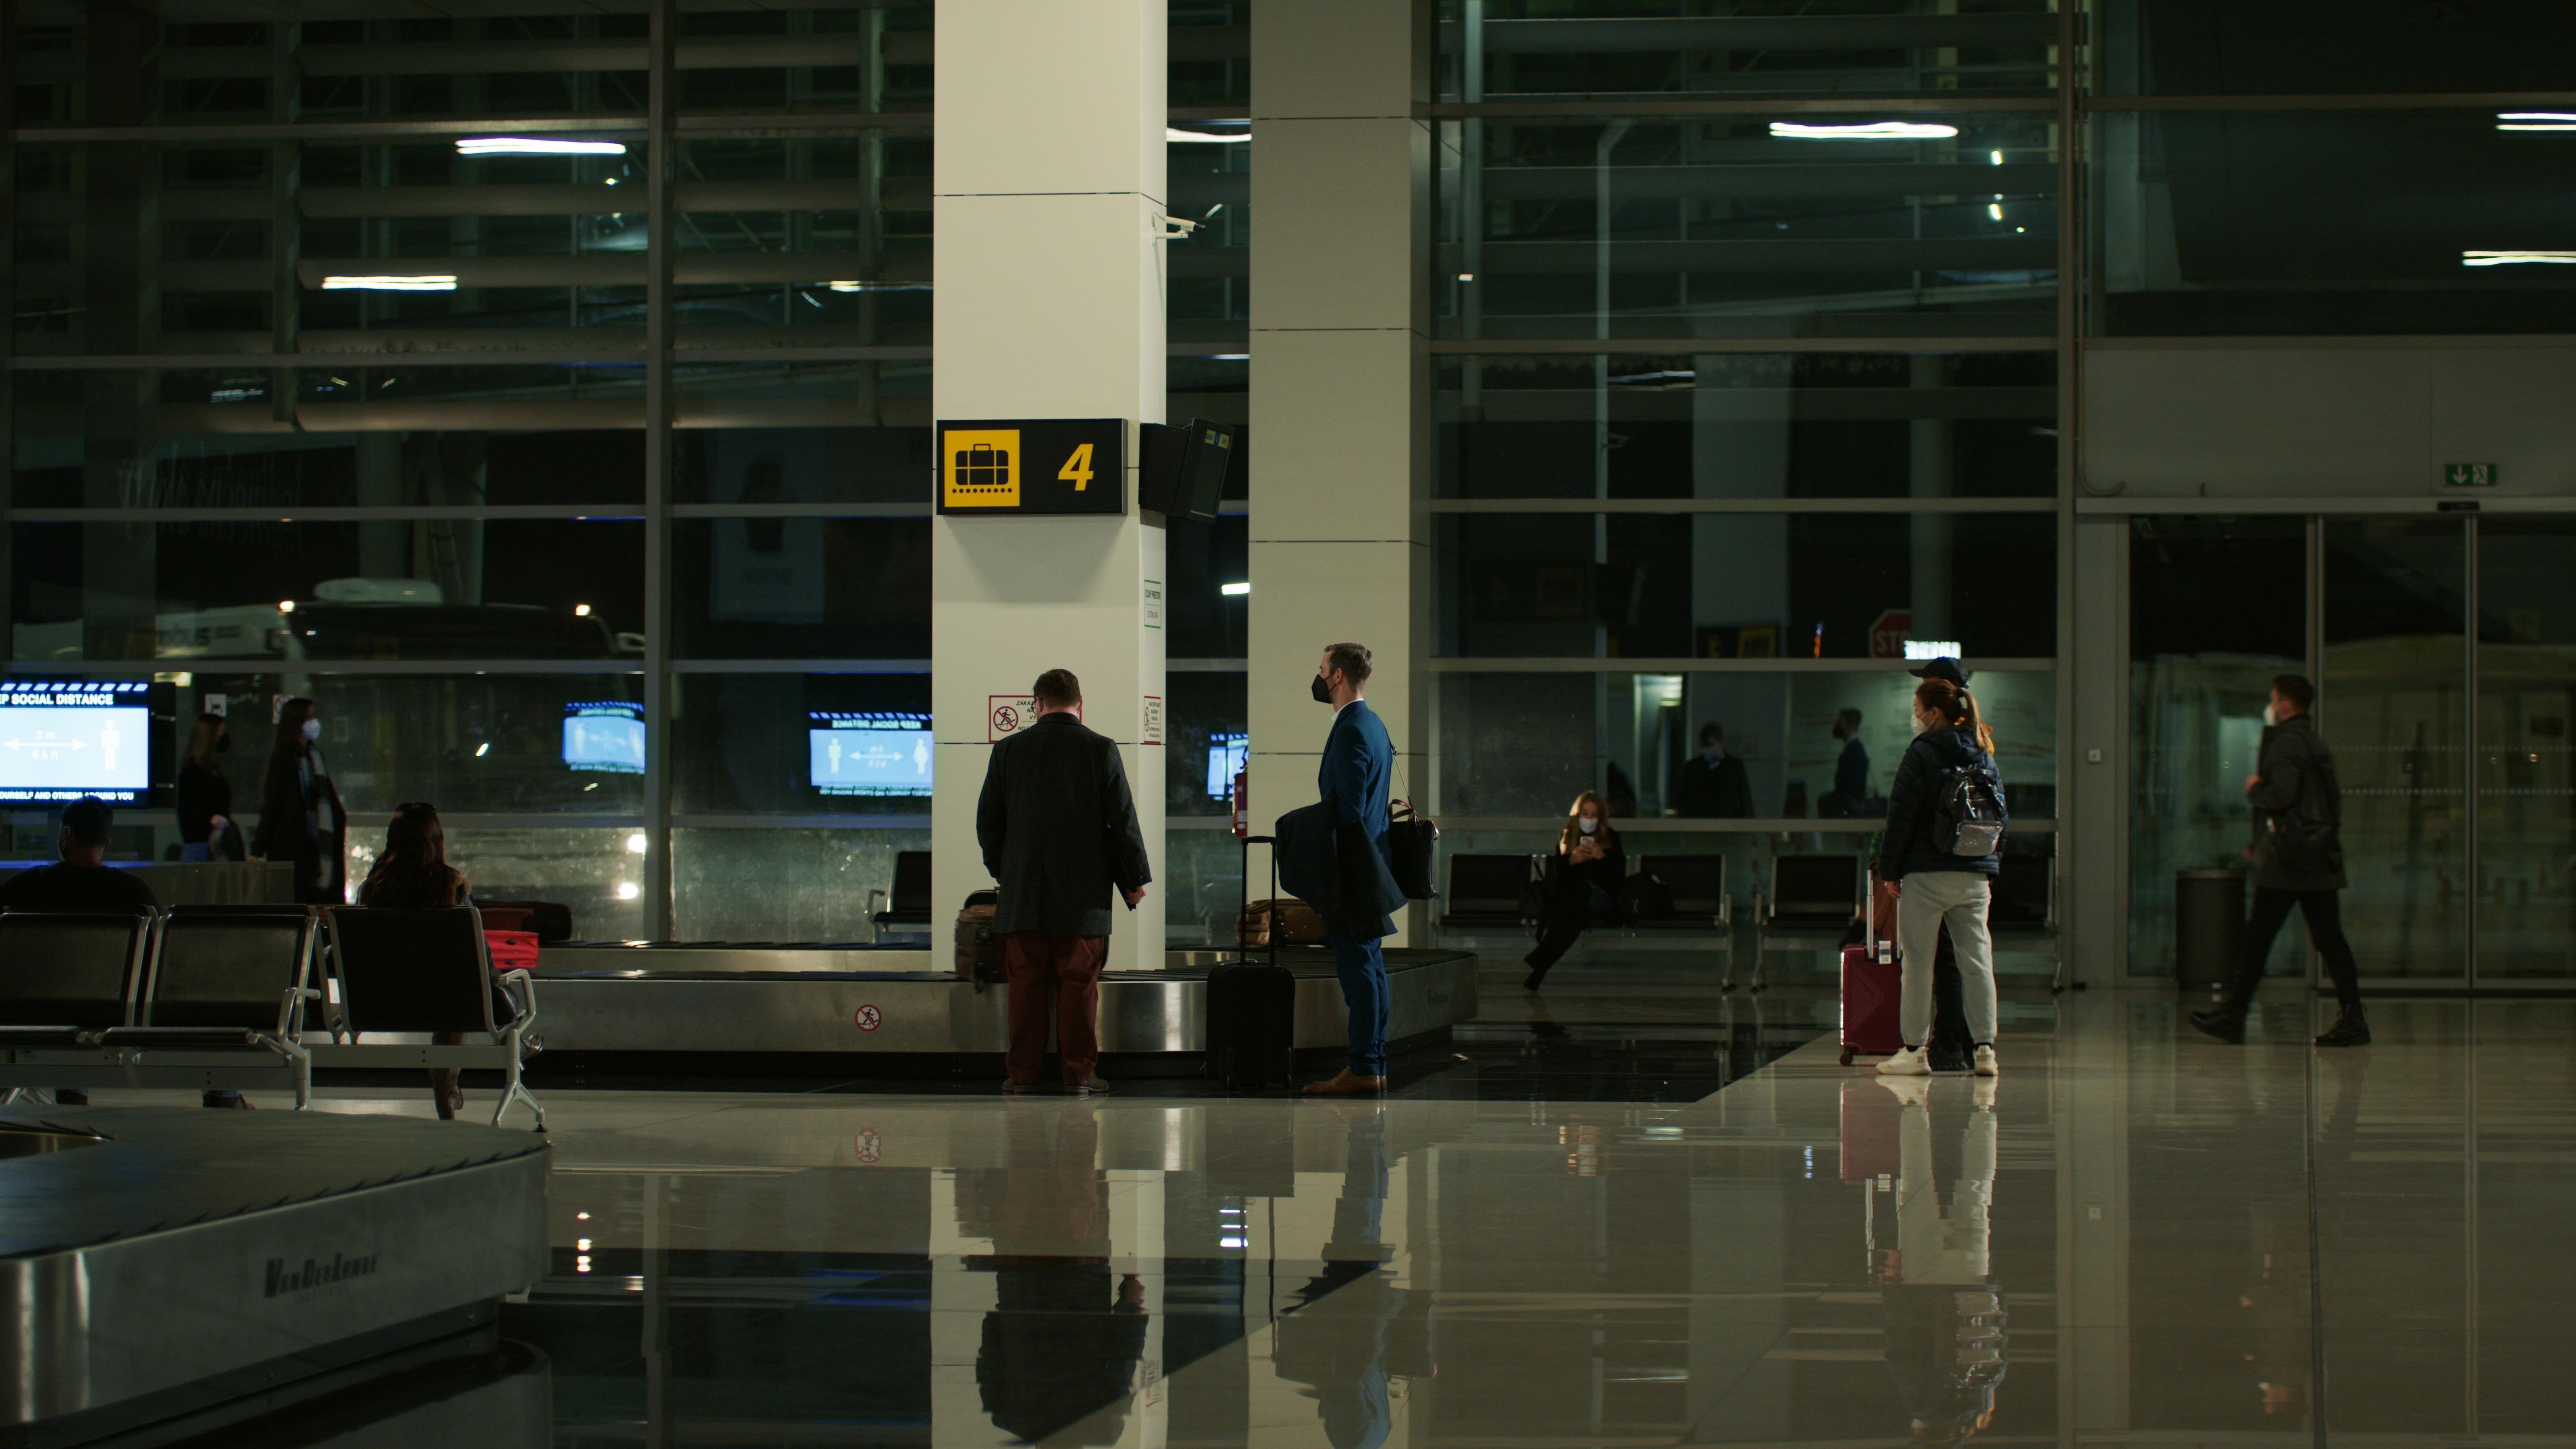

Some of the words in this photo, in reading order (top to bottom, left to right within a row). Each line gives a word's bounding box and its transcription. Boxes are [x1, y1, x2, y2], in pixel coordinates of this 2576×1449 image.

[1057, 444, 1094, 491] 4
[11, 694, 54, 705] SOCIAL
[56, 694, 114, 705] DISTANCE
[36, 730, 42, 739] 2
[50, 750, 59, 760] ft
